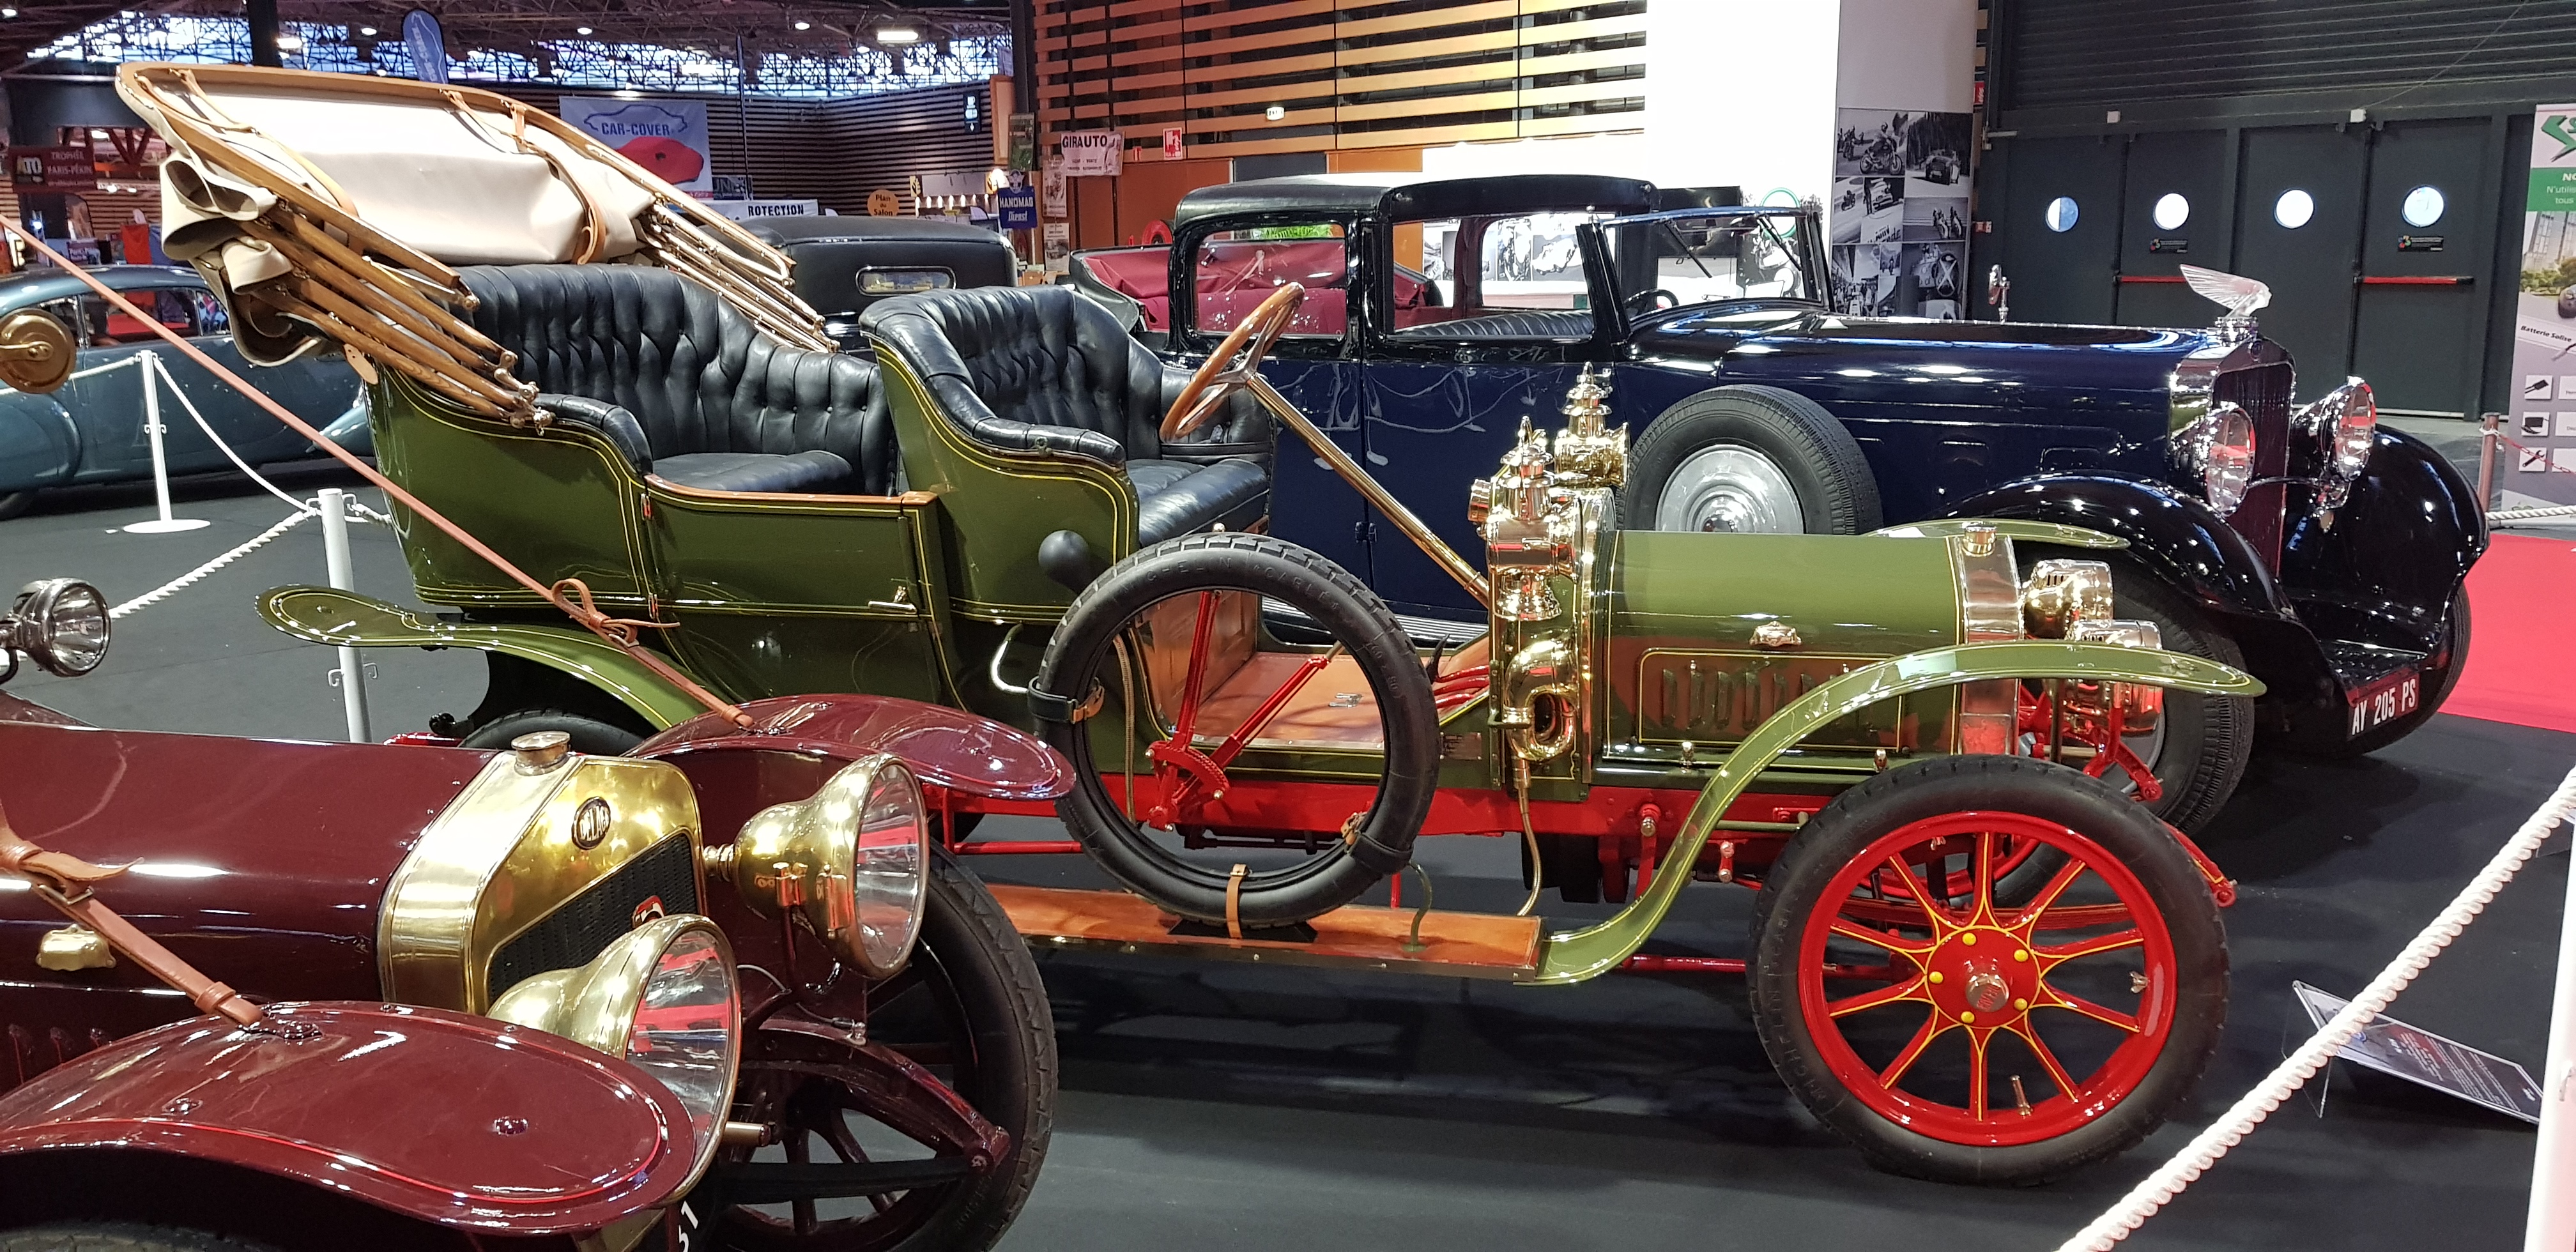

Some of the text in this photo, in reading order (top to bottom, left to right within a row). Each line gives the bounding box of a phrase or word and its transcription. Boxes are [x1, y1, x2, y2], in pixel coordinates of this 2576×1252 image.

[601, 123, 670, 135] CAR-COVER
[1062, 135, 1107, 148] GIRAUTO
[873, 208, 893, 217] Salon
[2352, 678, 2416, 735] AY 205 PS
